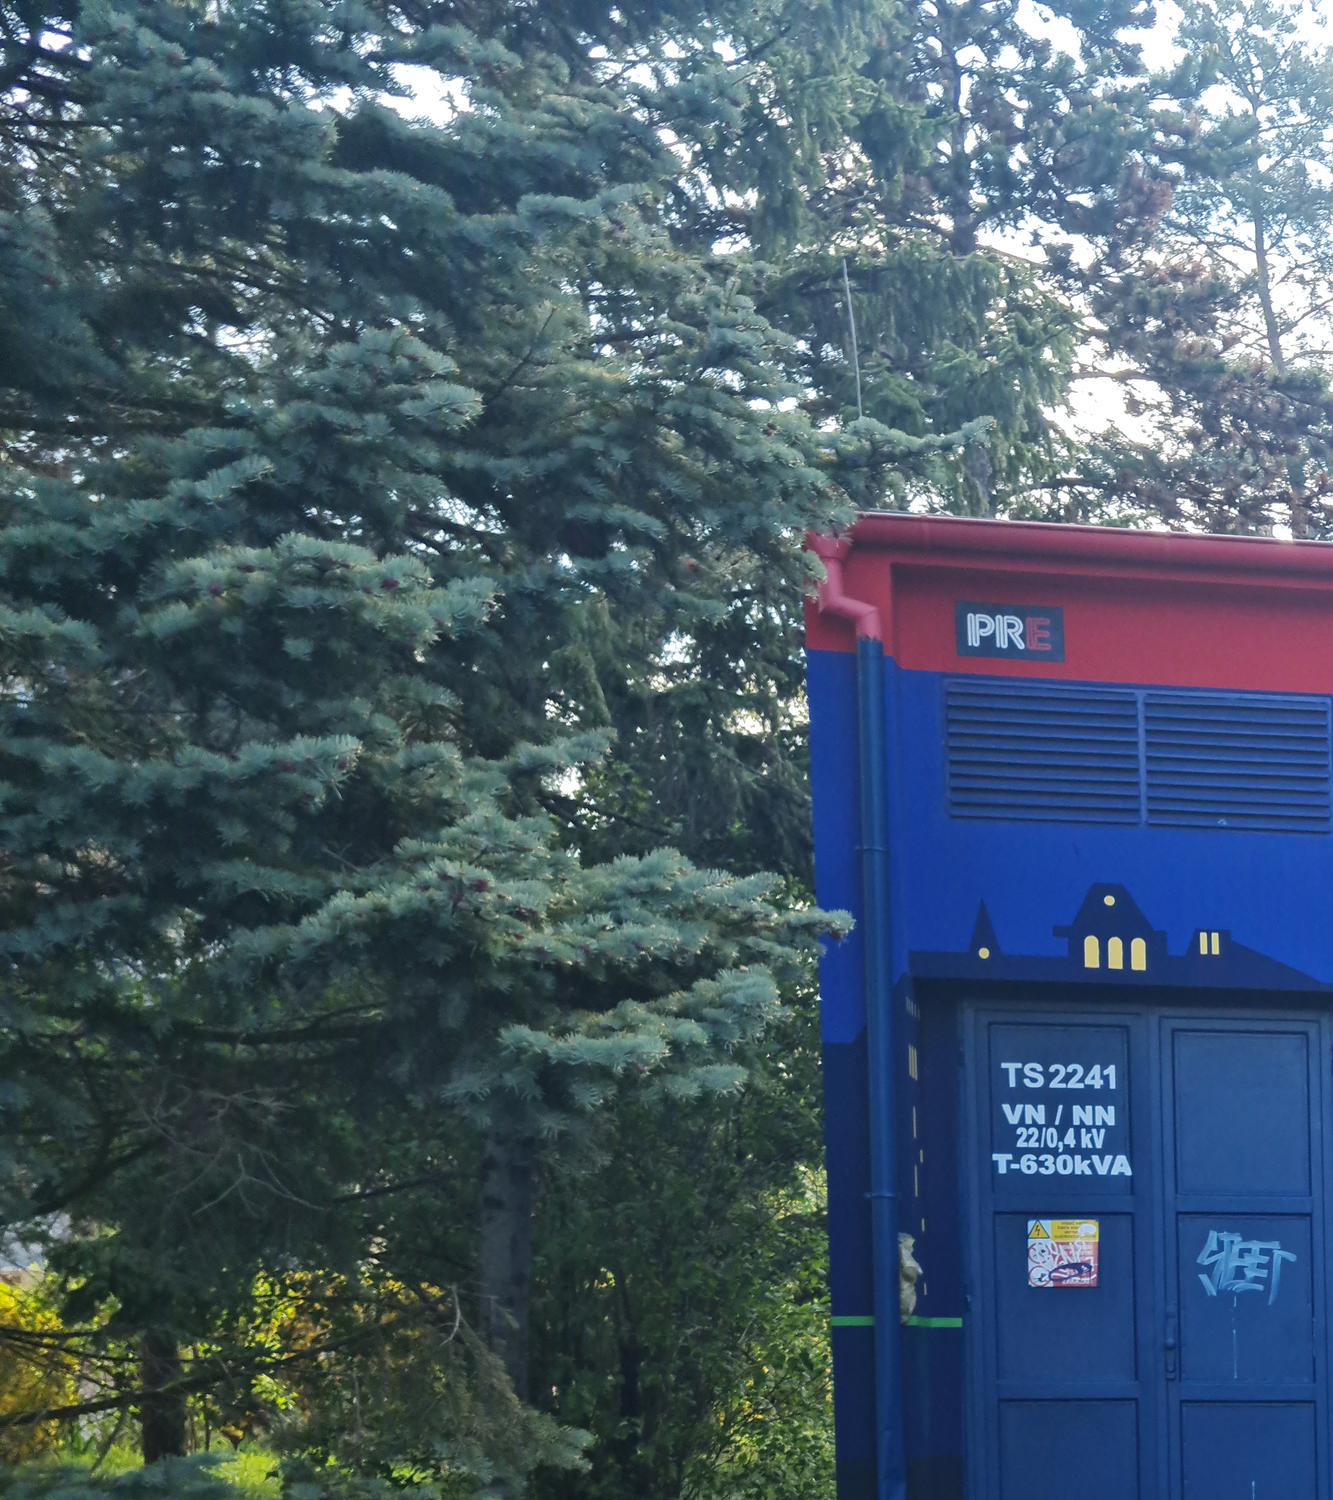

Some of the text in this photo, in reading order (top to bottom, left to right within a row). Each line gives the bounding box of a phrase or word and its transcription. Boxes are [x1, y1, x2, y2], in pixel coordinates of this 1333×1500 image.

[967, 612, 1052, 650] PRE
[1001, 1062, 1116, 1089] TS 2241
[1002, 1104, 1115, 1126] VN / NN
[1016, 1127, 1105, 1152] 22/0,4 kV
[992, 1153, 1133, 1176] T-630kVA
